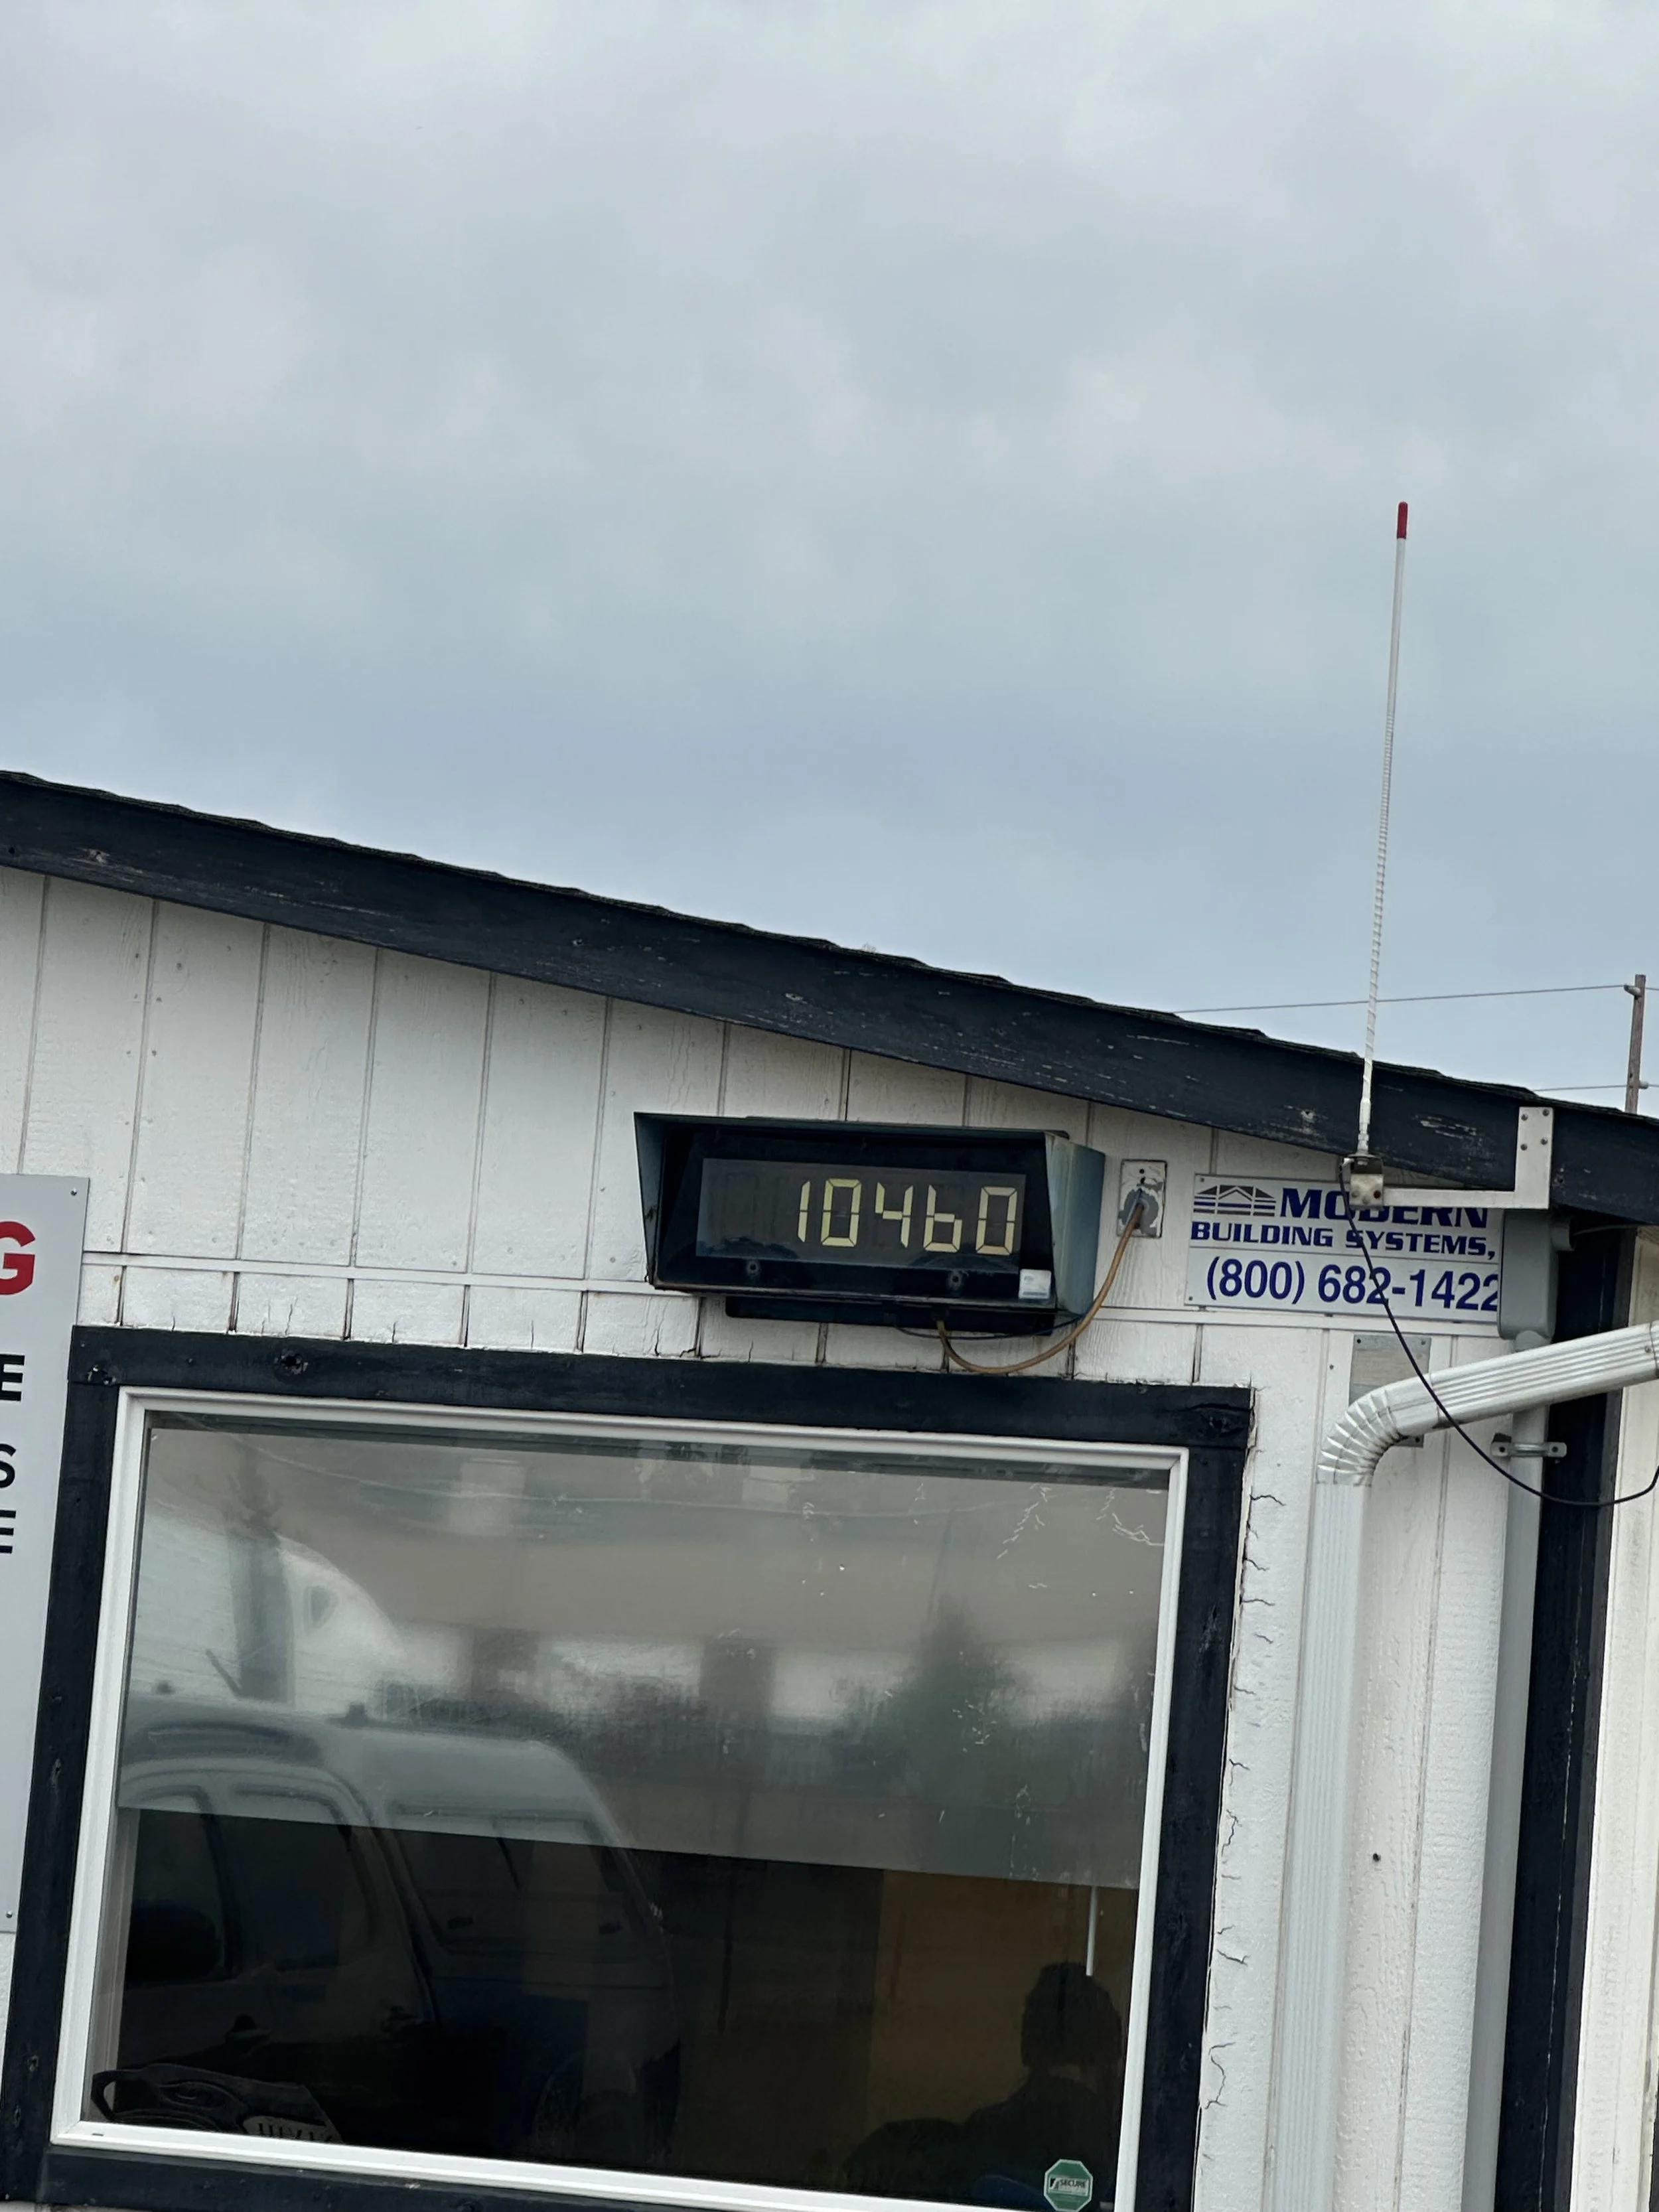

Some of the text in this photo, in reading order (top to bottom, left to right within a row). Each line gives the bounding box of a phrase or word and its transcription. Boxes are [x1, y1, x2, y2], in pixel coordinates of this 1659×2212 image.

[797, 1177, 1018, 1256] 10460
[1190, 1221, 1496, 1260] BUILDING SYSTEMS,
[1206, 1256, 1499, 1312] (800) 682-1422
